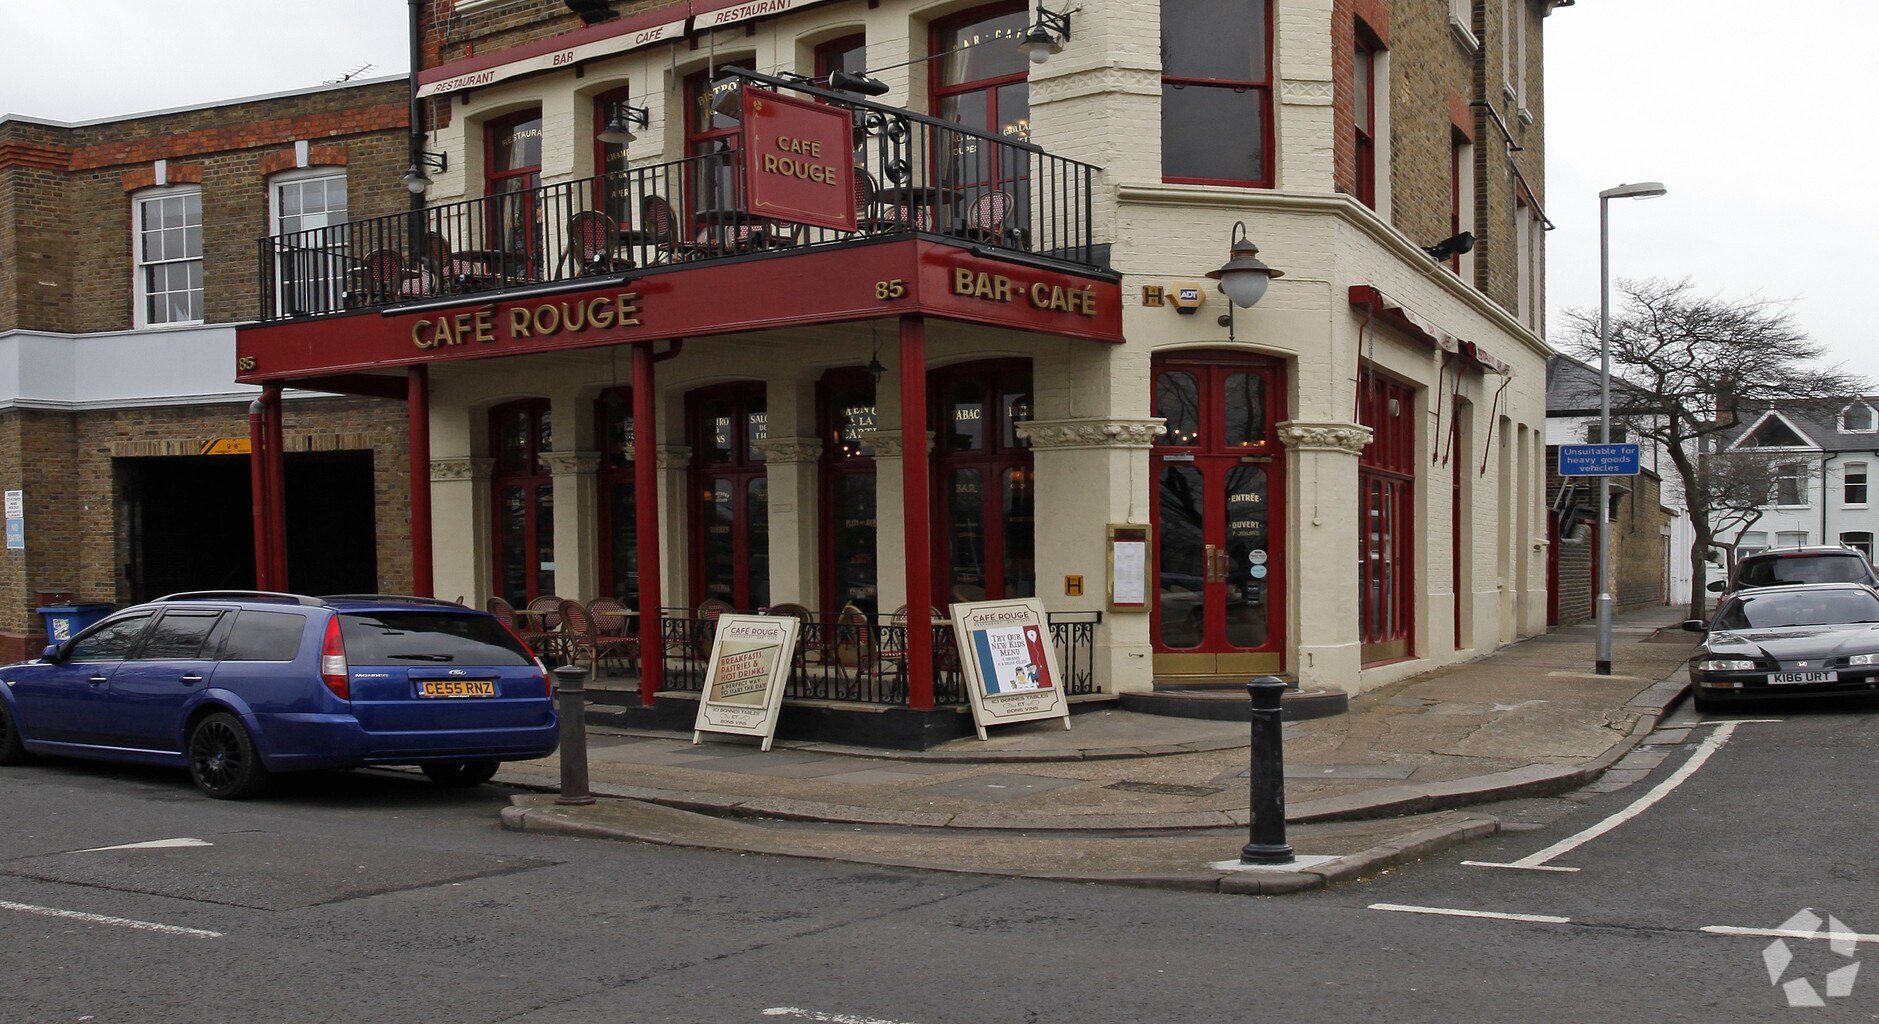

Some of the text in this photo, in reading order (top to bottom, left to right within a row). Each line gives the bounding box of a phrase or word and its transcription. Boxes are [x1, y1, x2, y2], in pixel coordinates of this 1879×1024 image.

[433, 27, 663, 93] RESTAURANT BAR CAFÉ
[764, 153, 836, 186] ROUGE
[874, 279, 905, 301] 85
[953, 267, 1097, 316] BAR CAFÉ
[1180, 290, 1198, 299] ADT
[410, 291, 642, 349] CAFÉ ROUGE
[239, 356, 257, 371] 85
[859, 416, 873, 426] LA
[1564, 447, 1616, 455] Unsuitable
[1601, 456, 1631, 464] goods
[1579, 464, 1619, 472] vehicles
[1231, 492, 1260, 503] ENTRÉE
[1231, 521, 1260, 529] OUVERT
[1067, 577, 1081, 593] H
[998, 610, 1029, 620] ROUGE
[752, 628, 778, 636] ROUGE
[721, 660, 758, 674] PASTRIES &
[721, 666, 764, 681] HOT DRINKS
[1774, 672, 1830, 683] K186 URT
[425, 682, 493, 694] CE55 RNZ
[726, 681, 747, 689] PERFECT
